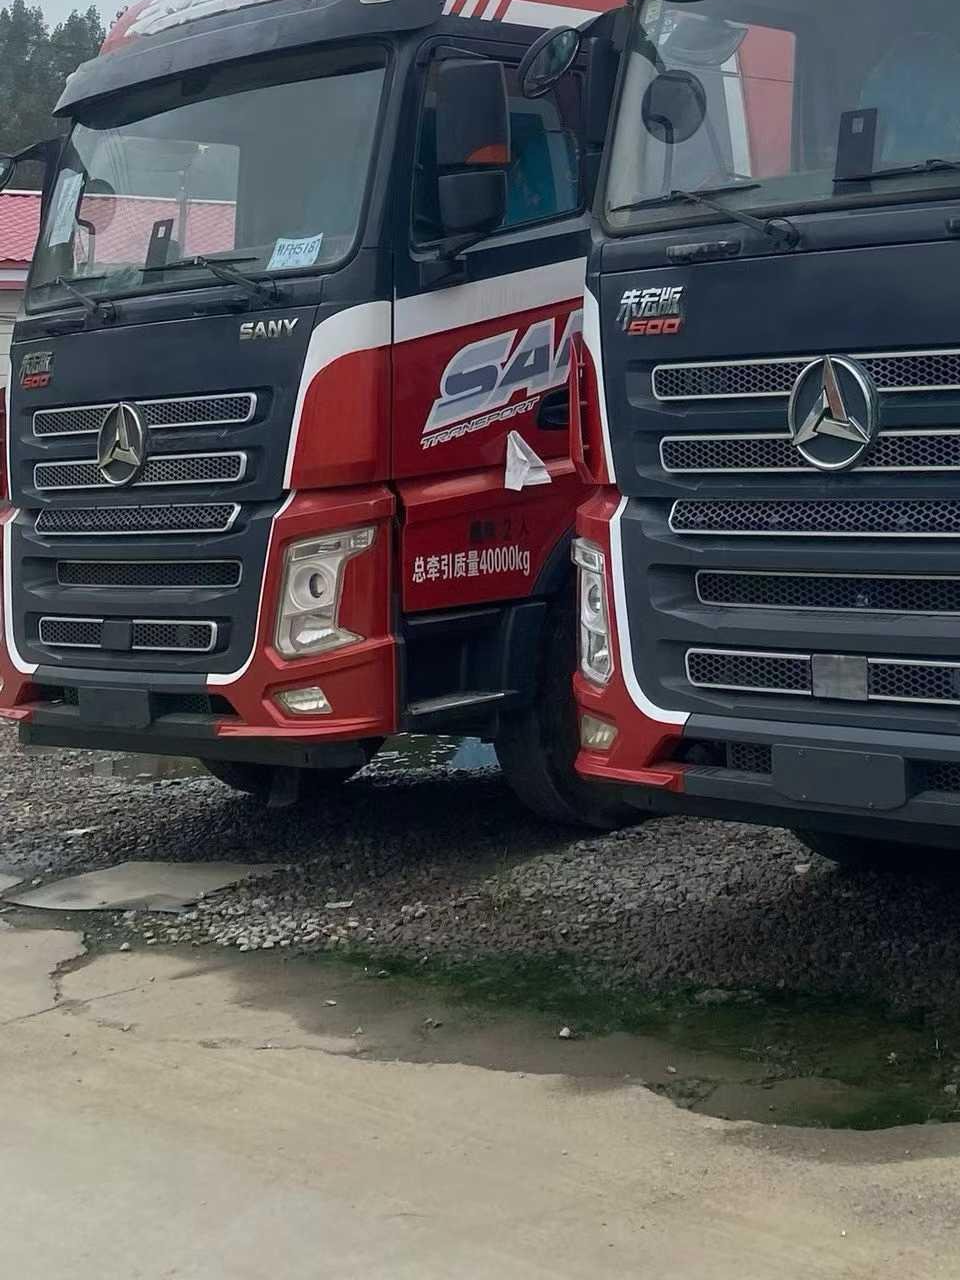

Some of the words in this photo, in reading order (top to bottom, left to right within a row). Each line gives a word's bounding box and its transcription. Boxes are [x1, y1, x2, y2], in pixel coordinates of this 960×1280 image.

[240, 318, 298, 340] SANY
[627, 318, 682, 336] 500
[420, 396, 542, 450] TRANSPORT
[412, 545, 531, 583] 总牵引质量40000kg
